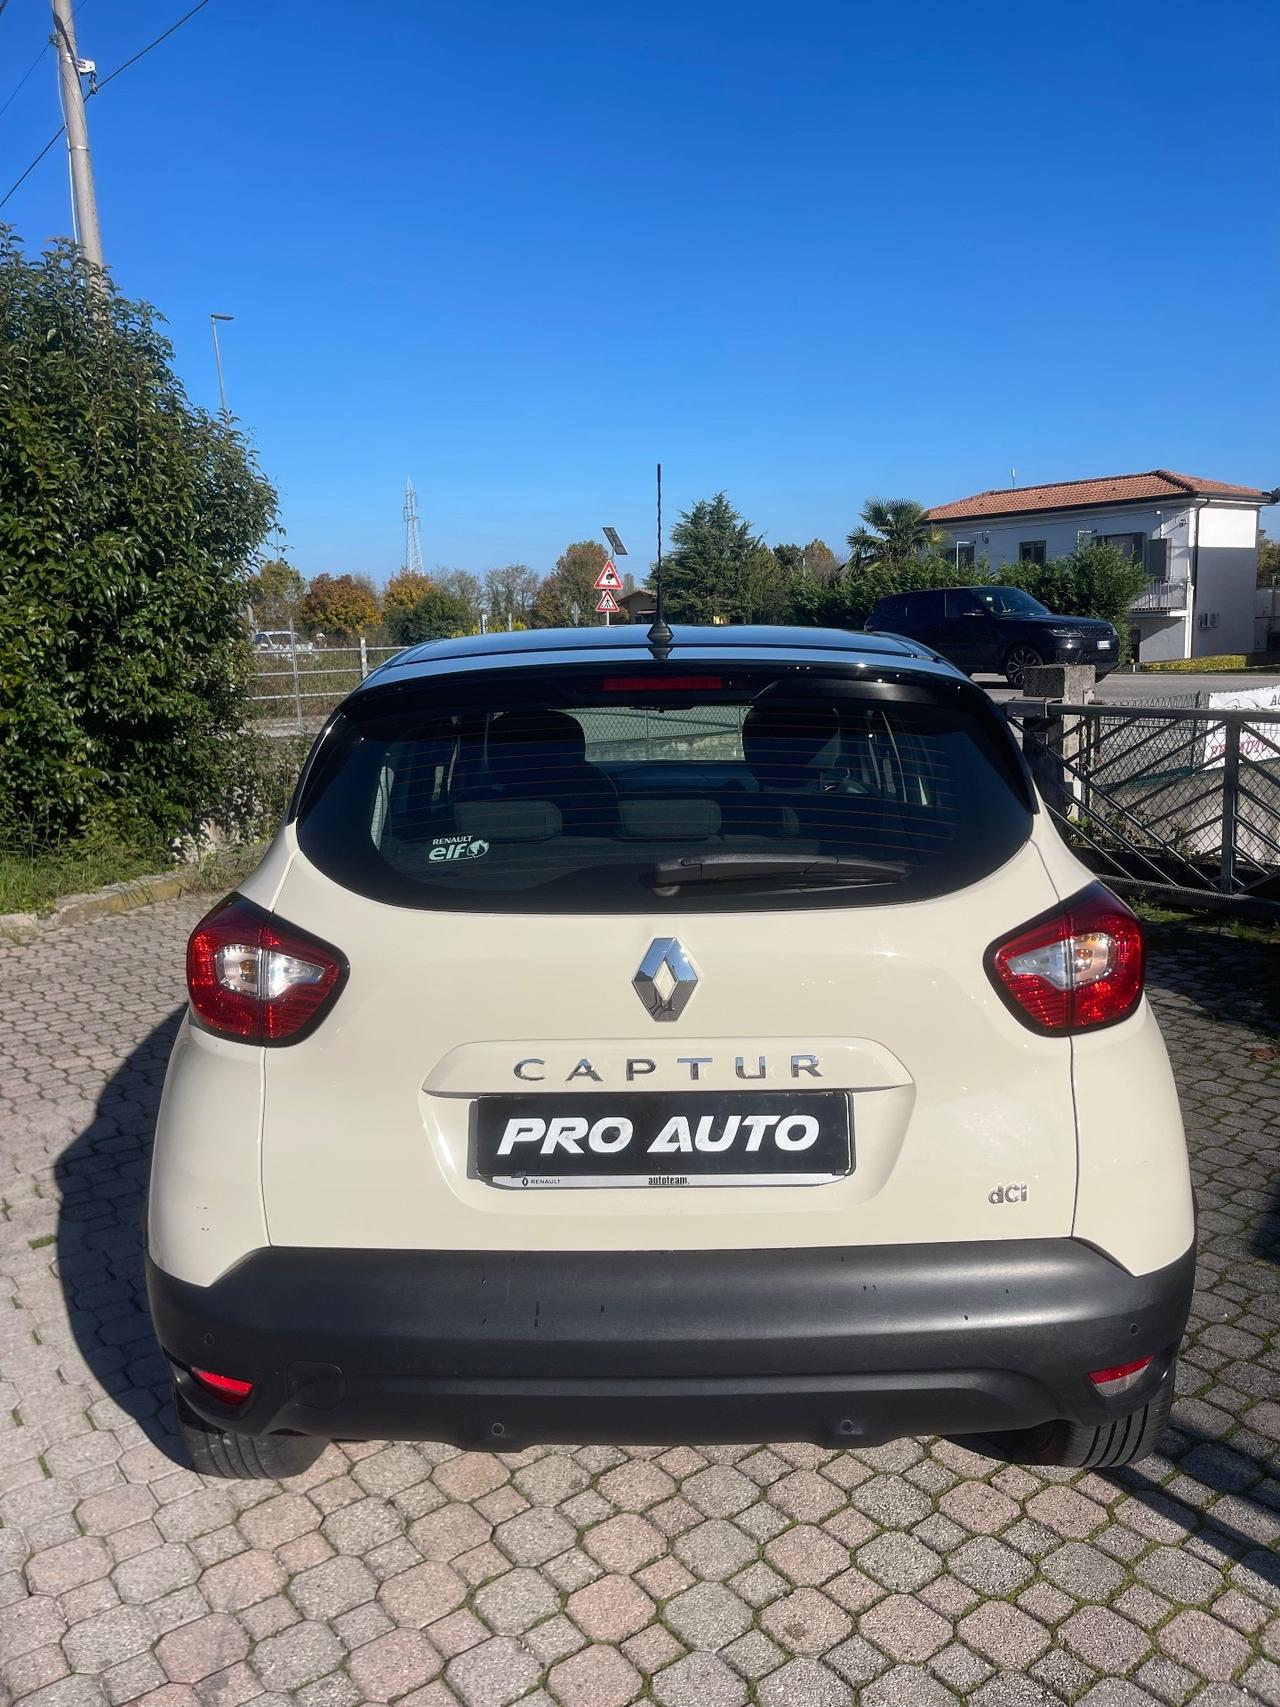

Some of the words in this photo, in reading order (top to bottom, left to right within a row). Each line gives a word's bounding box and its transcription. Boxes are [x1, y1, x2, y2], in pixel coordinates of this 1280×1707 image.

[1269, 694, 1280, 707] A
[432, 835, 473, 846] RENAULT
[428, 843, 468, 860] elf
[513, 1054, 824, 1082] CAPTUR
[496, 1116, 634, 1155] PRO
[646, 1115, 821, 1153] AUTO
[988, 1184, 1028, 1204] dCi
